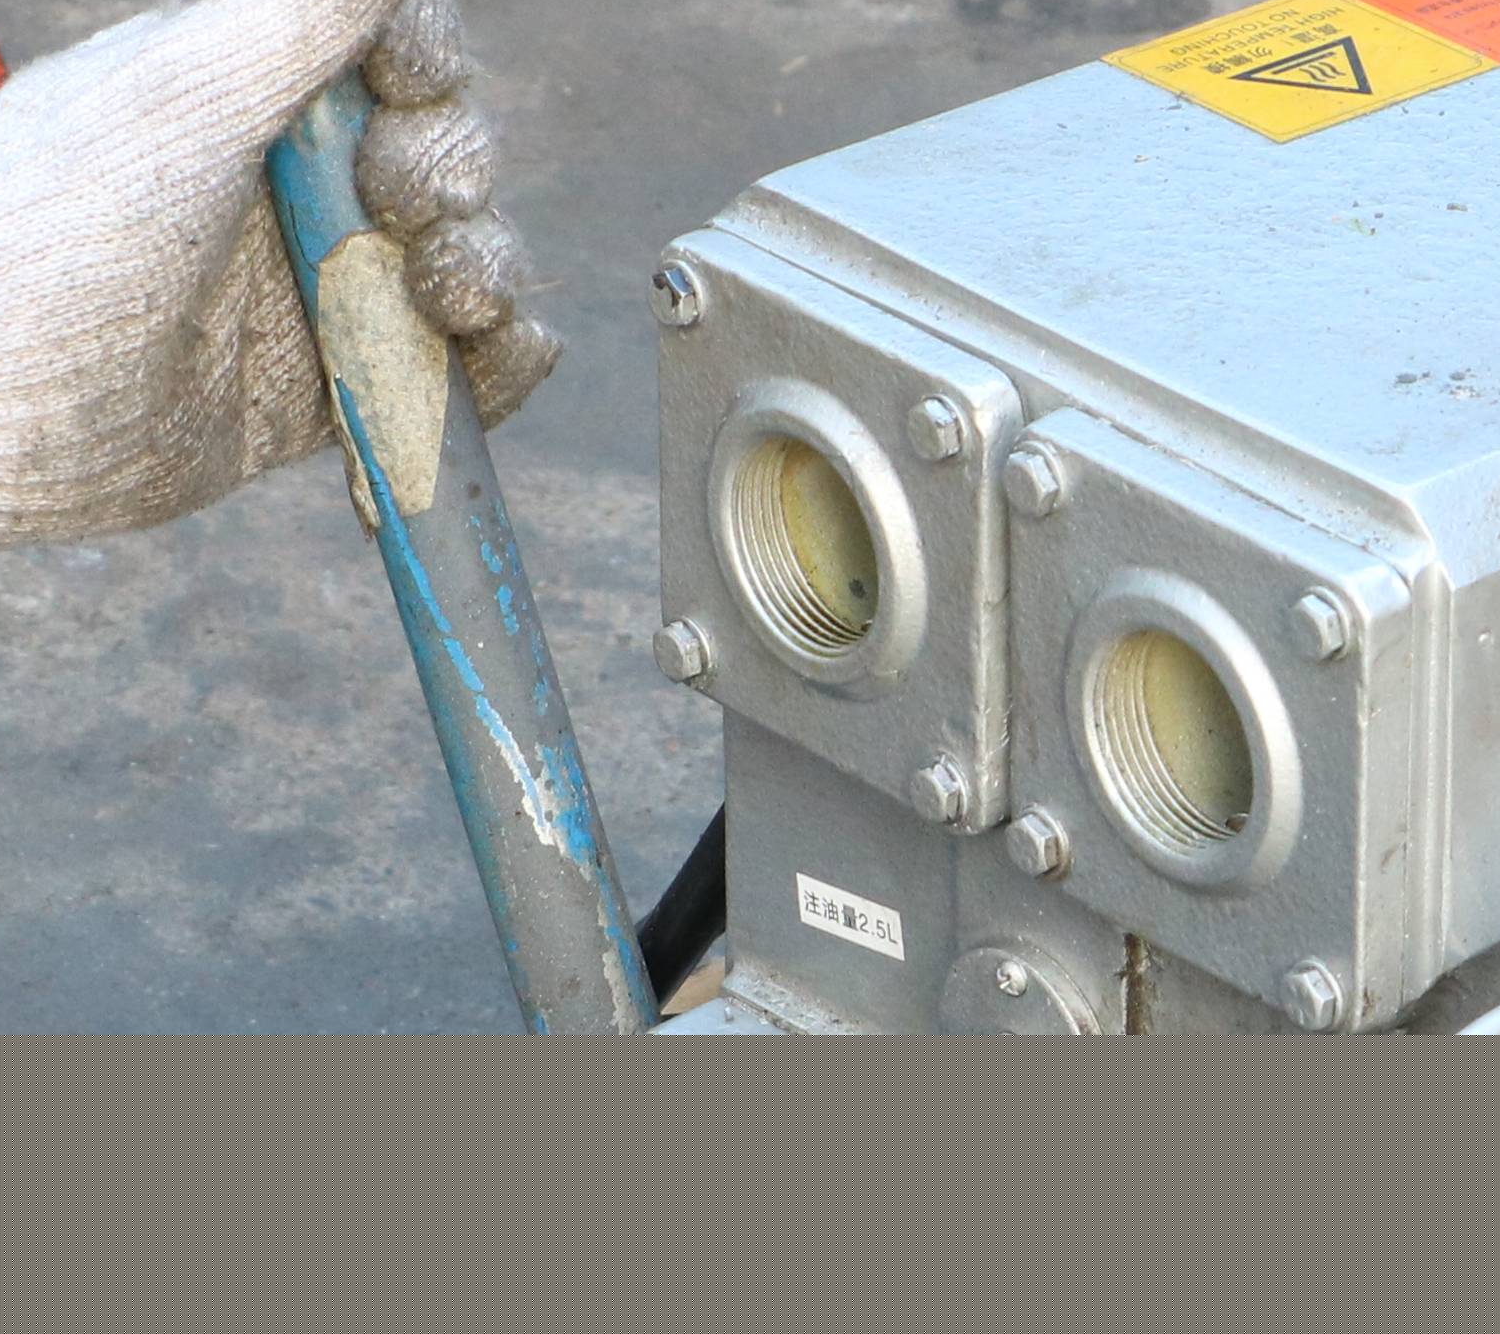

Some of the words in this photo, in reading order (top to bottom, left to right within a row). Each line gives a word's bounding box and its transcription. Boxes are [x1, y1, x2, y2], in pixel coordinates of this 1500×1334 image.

[1268, 8, 1299, 22] NO
[1300, 7, 1344, 26] HIGH
[1156, 23, 1296, 72] TEMPERATURE
[1169, 20, 1267, 54] TOUCHING
[803, 889, 899, 945] 注油量2.5L
